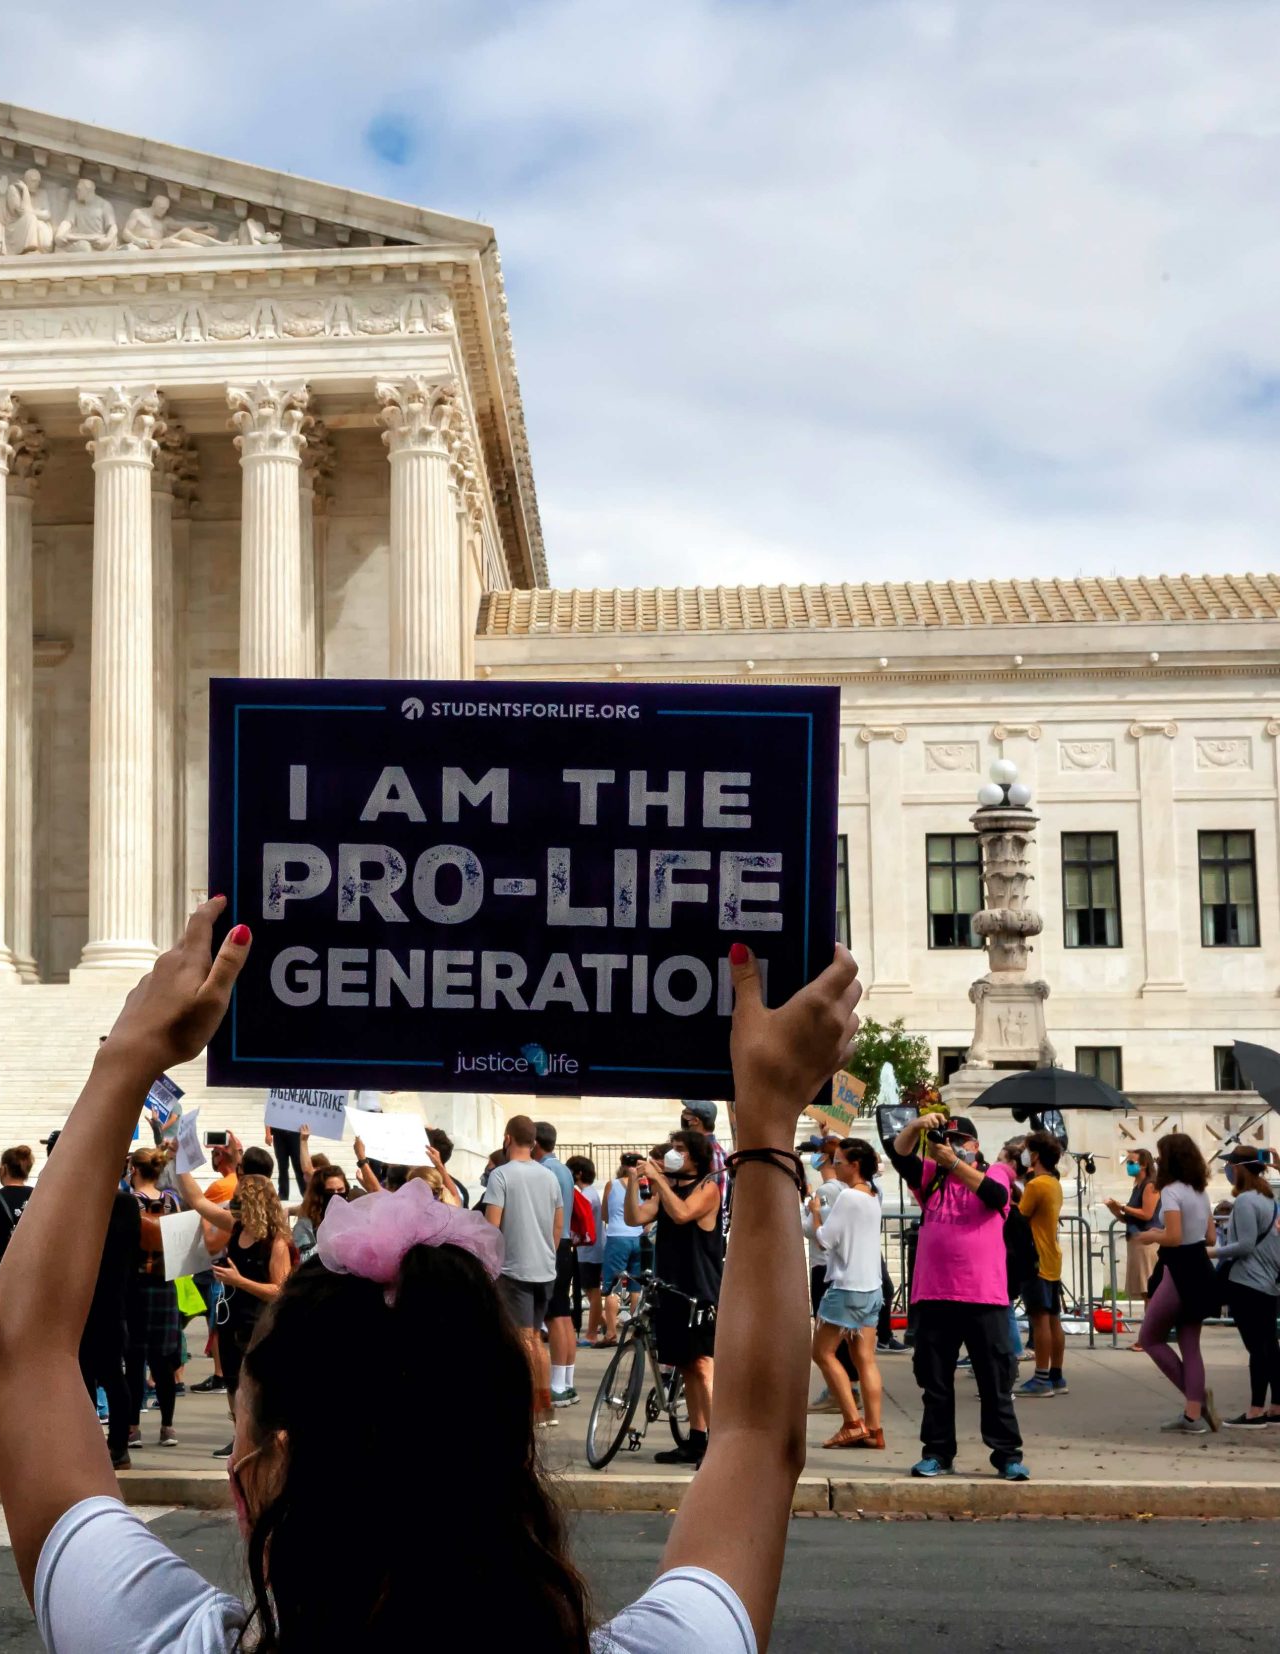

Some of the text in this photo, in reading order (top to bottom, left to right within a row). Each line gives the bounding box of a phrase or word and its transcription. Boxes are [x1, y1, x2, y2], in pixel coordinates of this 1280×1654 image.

[42, 317, 99, 339] LAW
[431, 702, 640, 719] STUDENTSFORLIFE.ORG
[289, 764, 752, 829] I AM THE
[261, 842, 783, 932] PRO-LIFE
